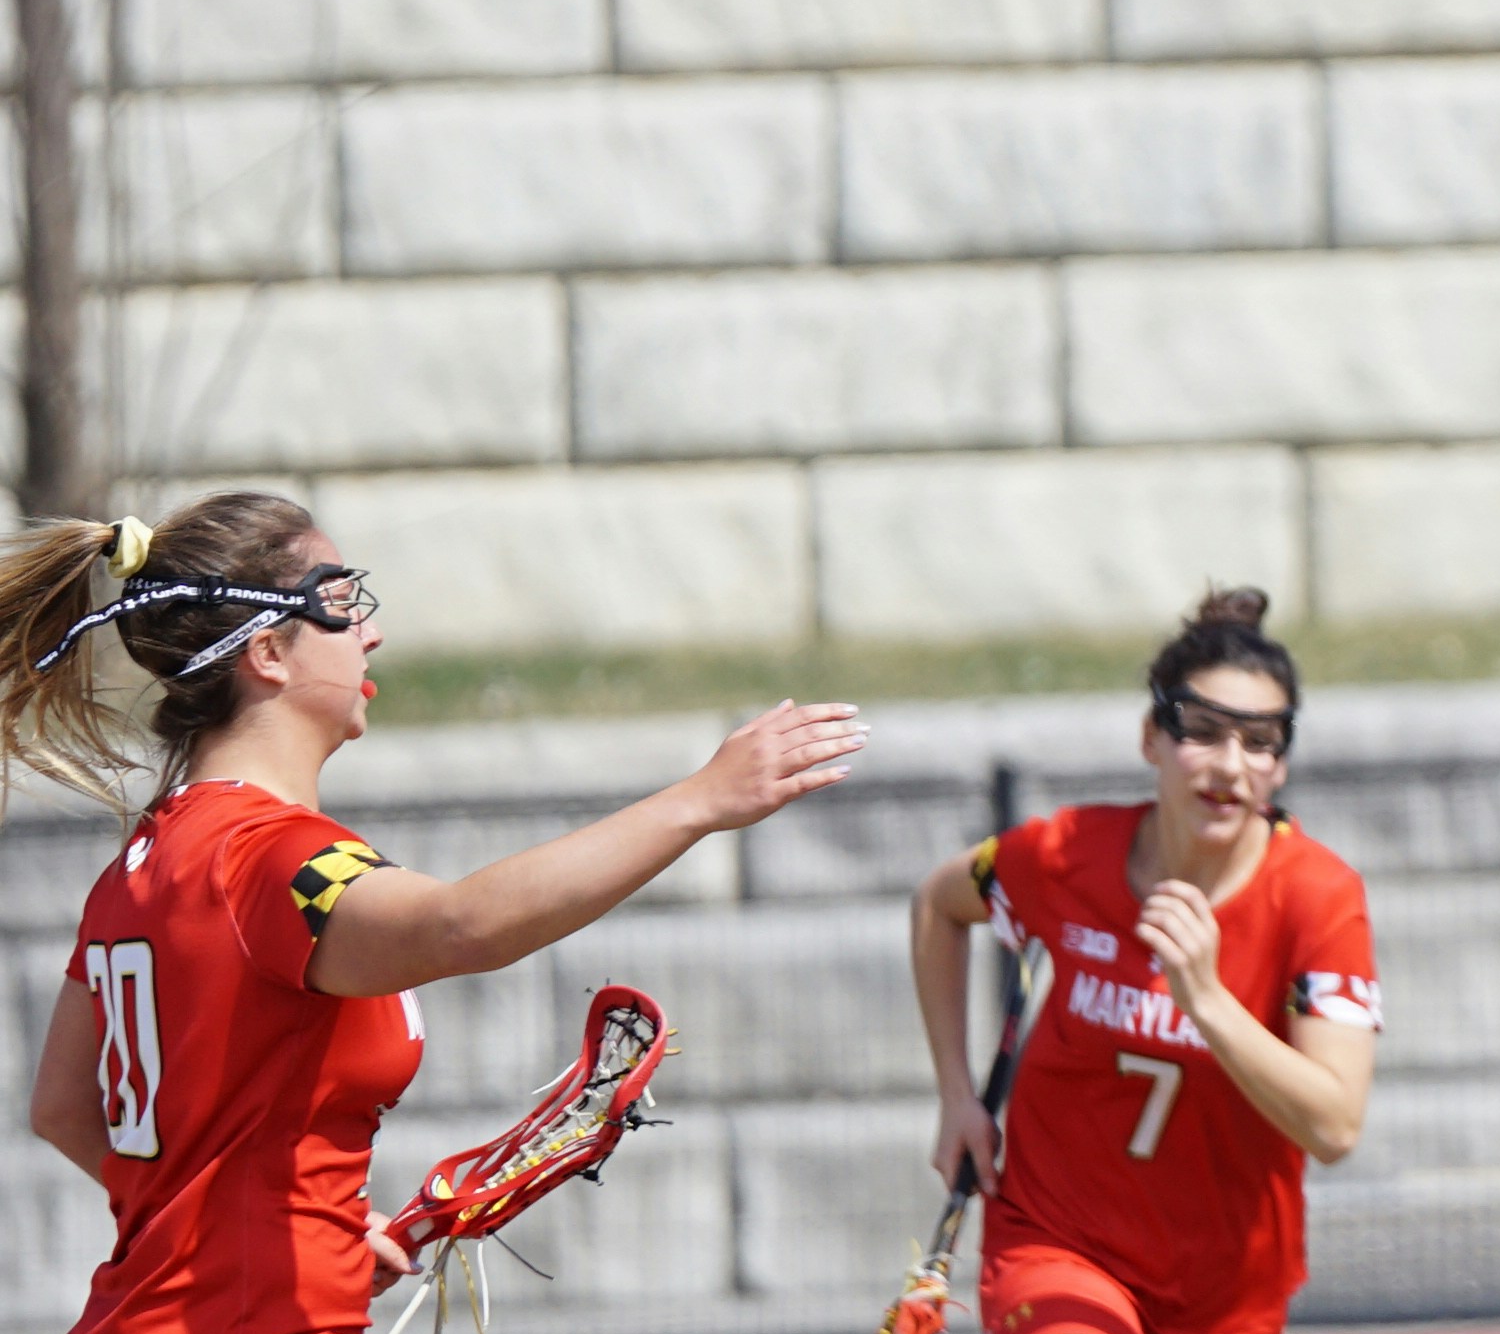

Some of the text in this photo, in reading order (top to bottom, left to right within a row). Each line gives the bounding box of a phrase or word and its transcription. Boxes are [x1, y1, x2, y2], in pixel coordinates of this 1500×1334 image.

[85, 937, 162, 1162] 20
[1068, 969, 1210, 1050] MARYLA
[1115, 1049, 1185, 1161] 7
